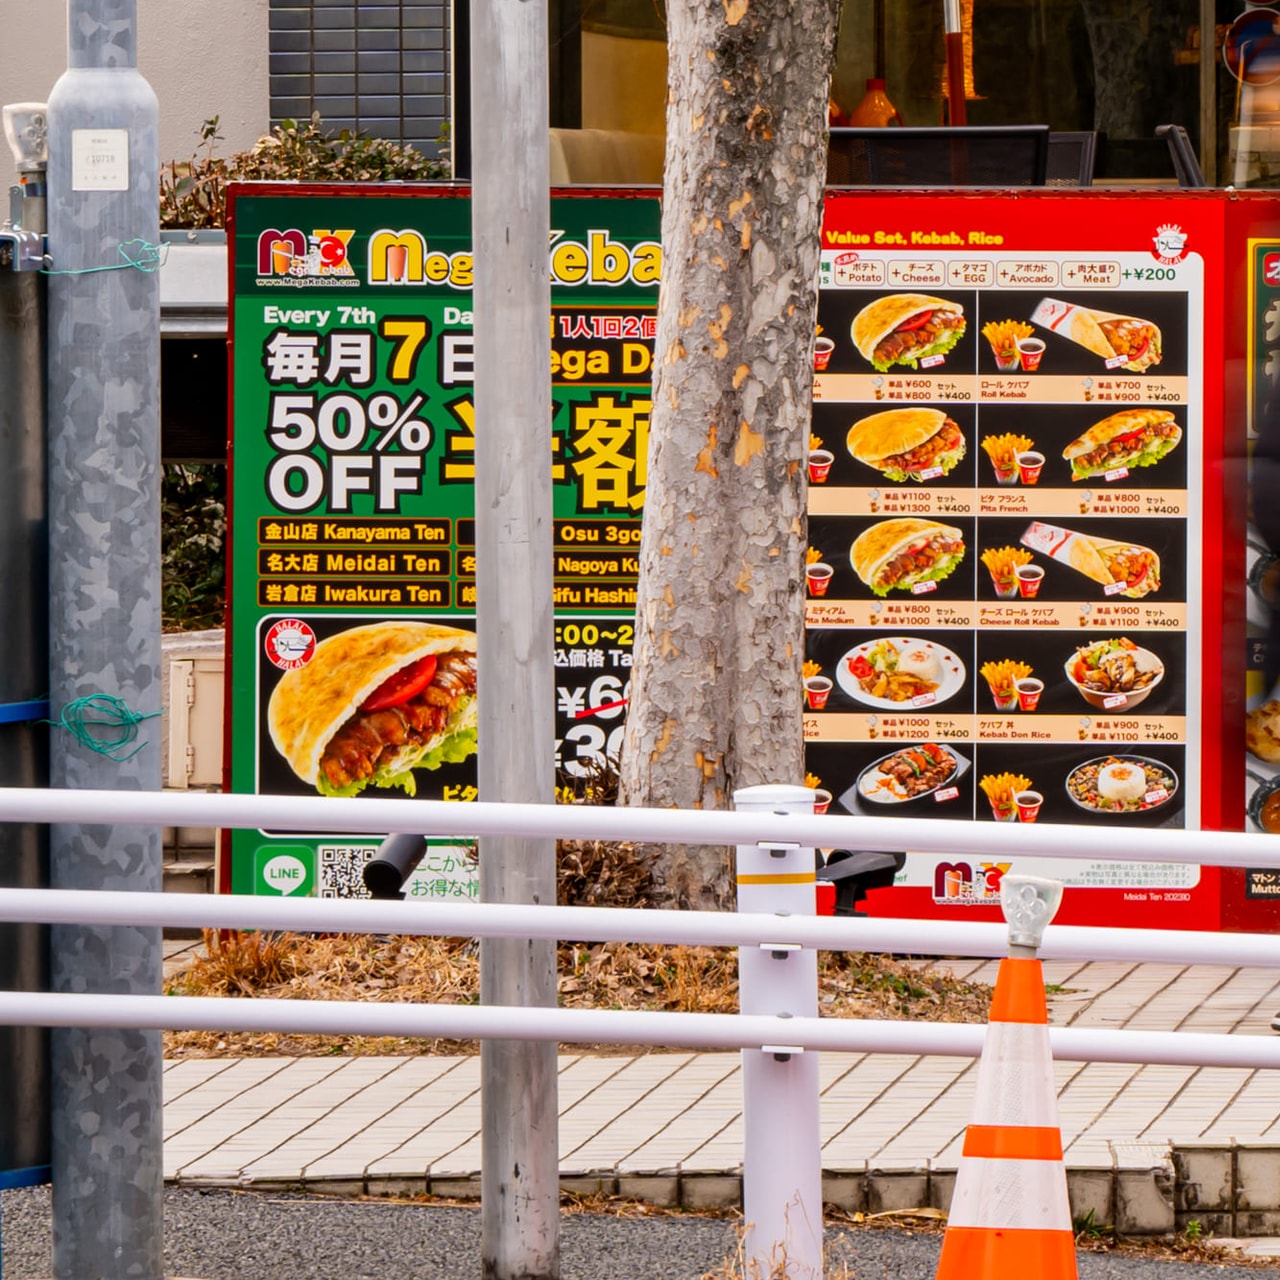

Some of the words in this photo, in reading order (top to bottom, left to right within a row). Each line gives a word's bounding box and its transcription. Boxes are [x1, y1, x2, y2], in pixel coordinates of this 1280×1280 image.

[826, 231, 870, 244] Value
[874, 231, 907, 245] Set,
[911, 231, 964, 245] Kebab,
[968, 231, 1004, 245] Rice
[368, 229, 473, 290] Meg
[549, 230, 662, 287] eba
[849, 274, 882, 283] Potato
[902, 274, 940, 283] Cheese
[964, 274, 986, 283] EGG
[1009, 275, 1054, 283] Avocado
[1083, 275, 1111, 283] Meat
[1122, 268, 1176, 281] +¥200
[264, 306, 331, 327] Every
[337, 306, 375, 324] 7th
[981, 390, 997, 398] Roll
[999, 390, 1027, 398] Kebab
[271, 395, 431, 452] 50%
[268, 455, 419, 510] OFF
[901, 492, 931, 501] ¥1100
[981, 504, 997, 512] Pita
[999, 504, 1028, 512] French
[1110, 505, 1140, 513] ¥1000
[265, 524, 318, 541] 金山店
[324, 524, 410, 543] Kanayama
[415, 525, 445, 541] Ten
[561, 526, 599, 542] Osu
[267, 553, 318, 572] 名大店
[326, 554, 396, 572] Meidai
[405, 555, 440, 571] Ten
[558, 558, 618, 575] Nagoya
[266, 585, 317, 602] 岩倉店
[325, 586, 401, 602] Iwakura
[407, 586, 441, 602] Ten
[980, 618, 1011, 626] Cheese
[1014, 618, 1030, 626] Roll
[1032, 618, 1060, 626] Kebab
[1113, 721, 1139, 729] ¥900
[270, 868, 299, 880] LINE
